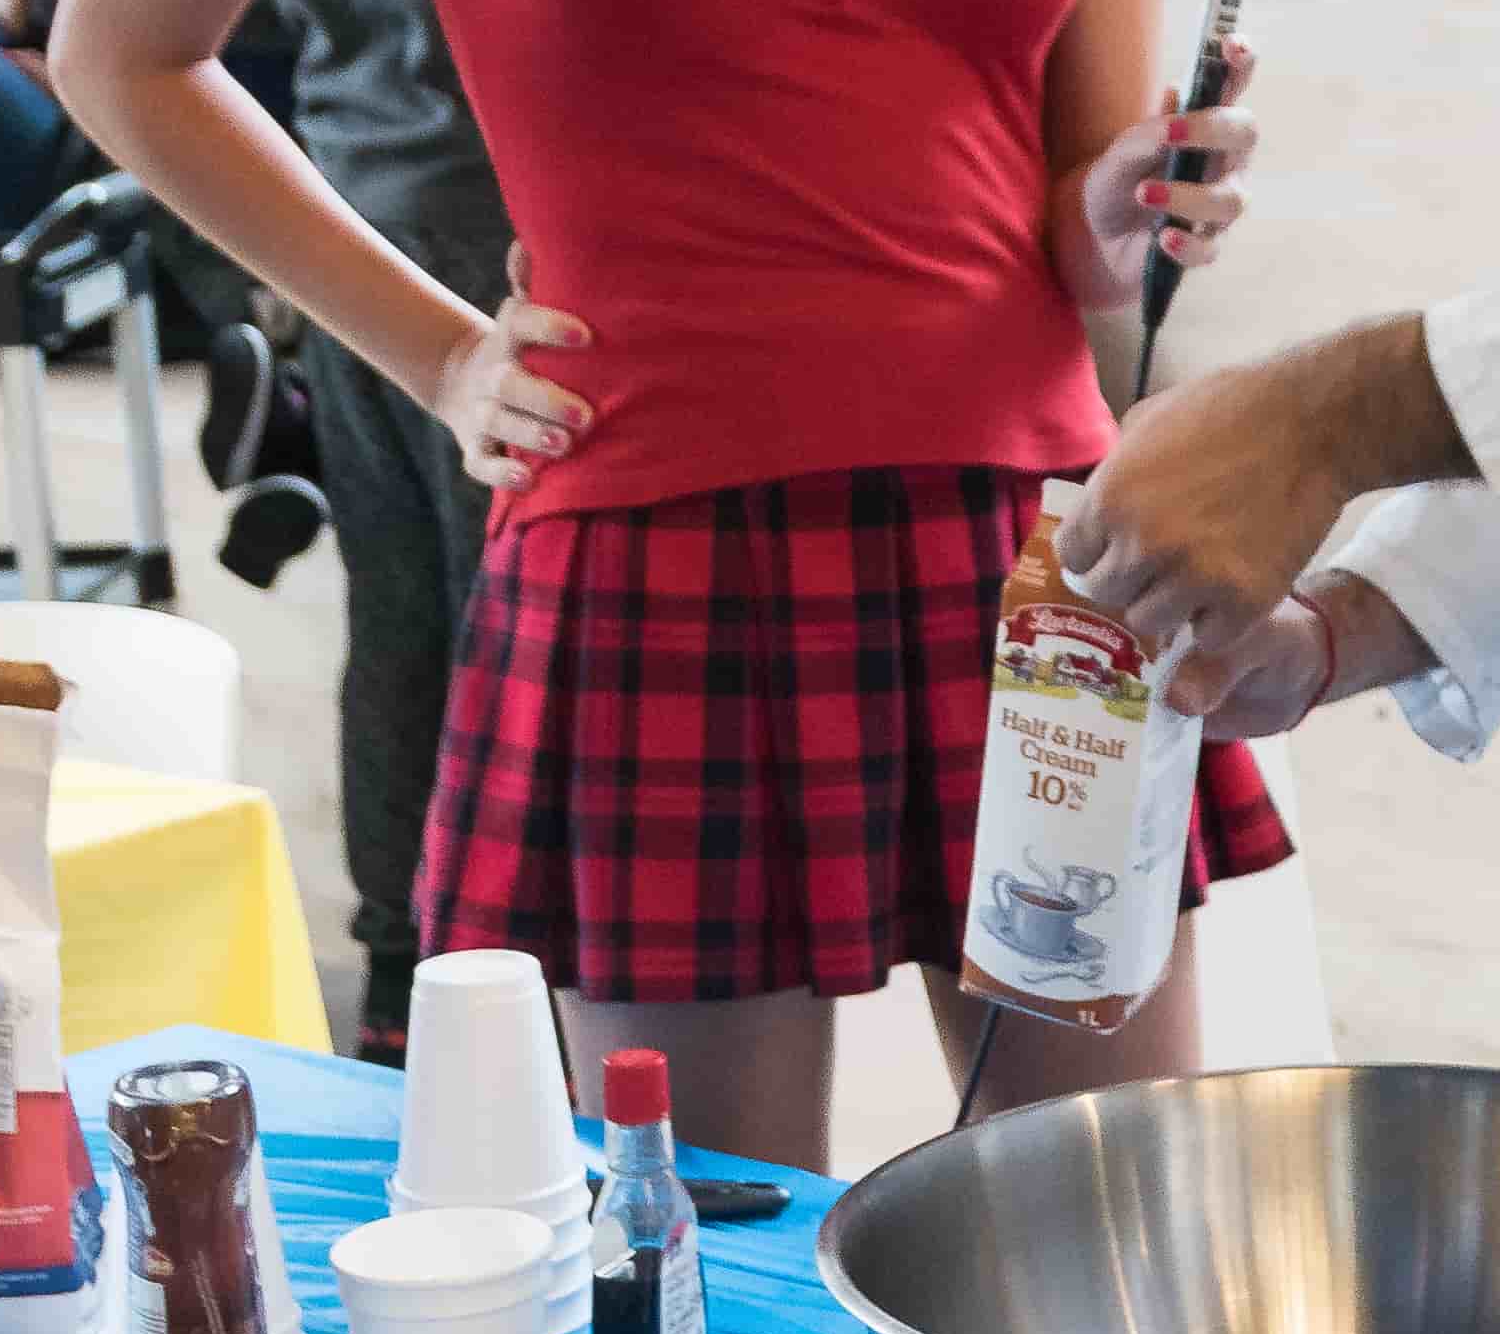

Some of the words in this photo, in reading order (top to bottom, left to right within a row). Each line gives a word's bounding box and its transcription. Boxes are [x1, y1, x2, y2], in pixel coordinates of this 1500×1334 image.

[1002, 707, 1047, 740] Half
[1052, 723, 1070, 746] &
[1075, 729, 1127, 759] Half
[1019, 738, 1098, 779] Cream
